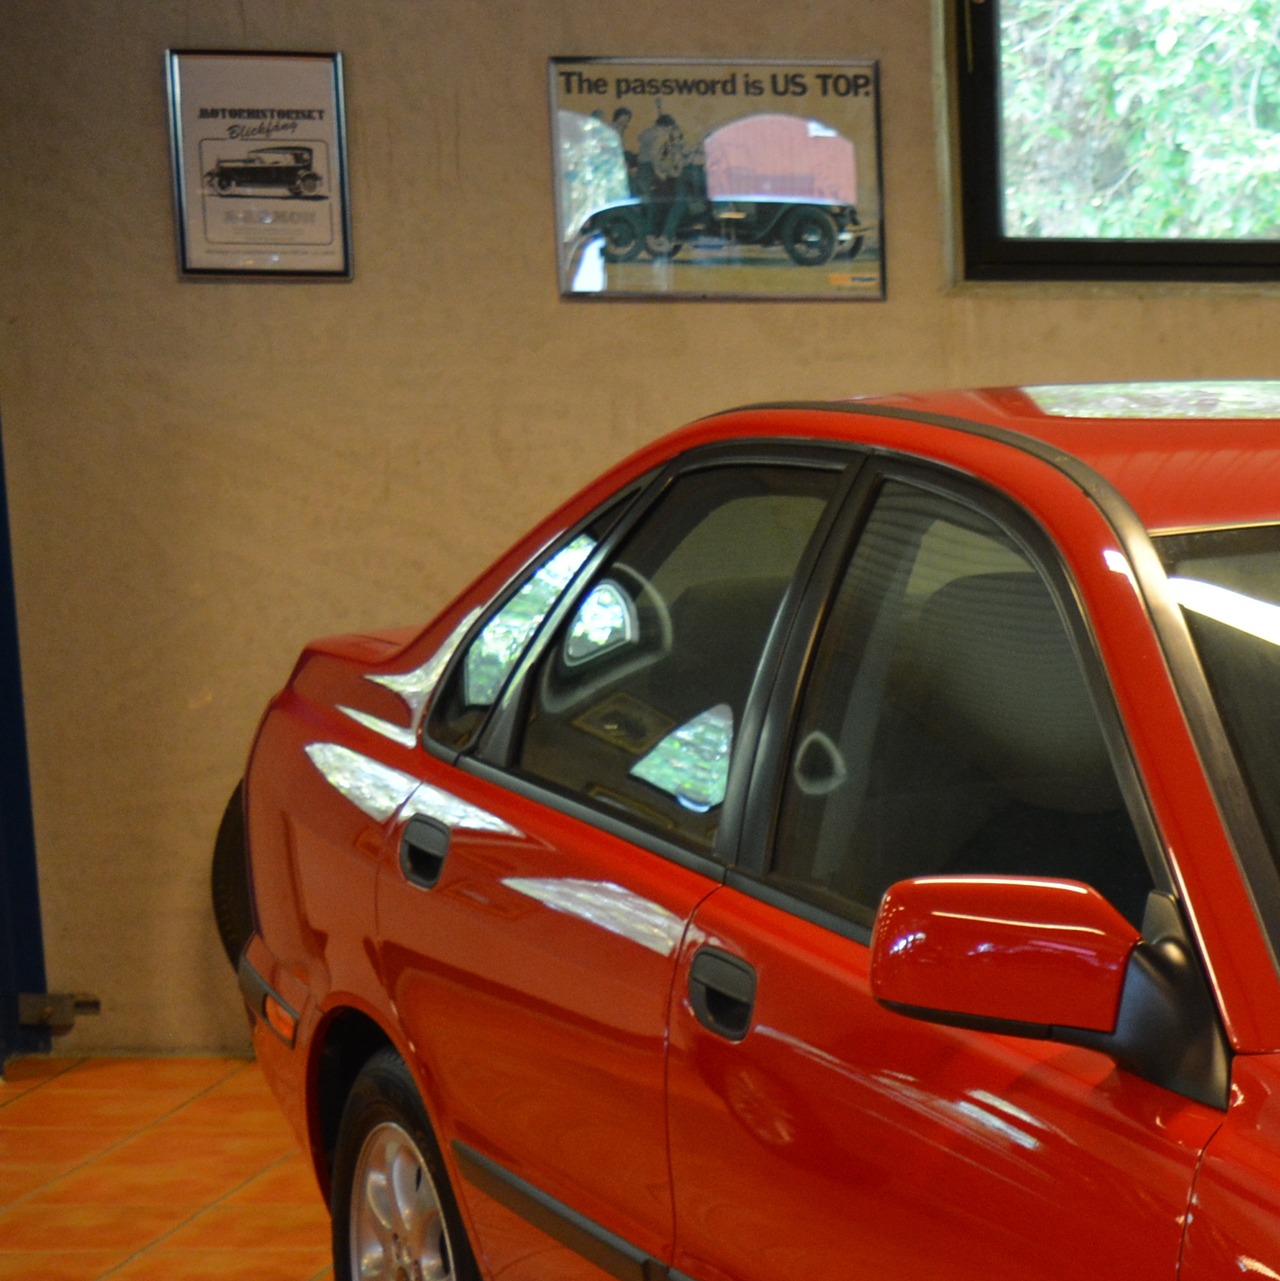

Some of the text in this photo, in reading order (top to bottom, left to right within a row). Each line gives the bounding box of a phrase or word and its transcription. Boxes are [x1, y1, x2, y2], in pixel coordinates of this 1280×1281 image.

[559, 71, 871, 99] The password is US TOP.
